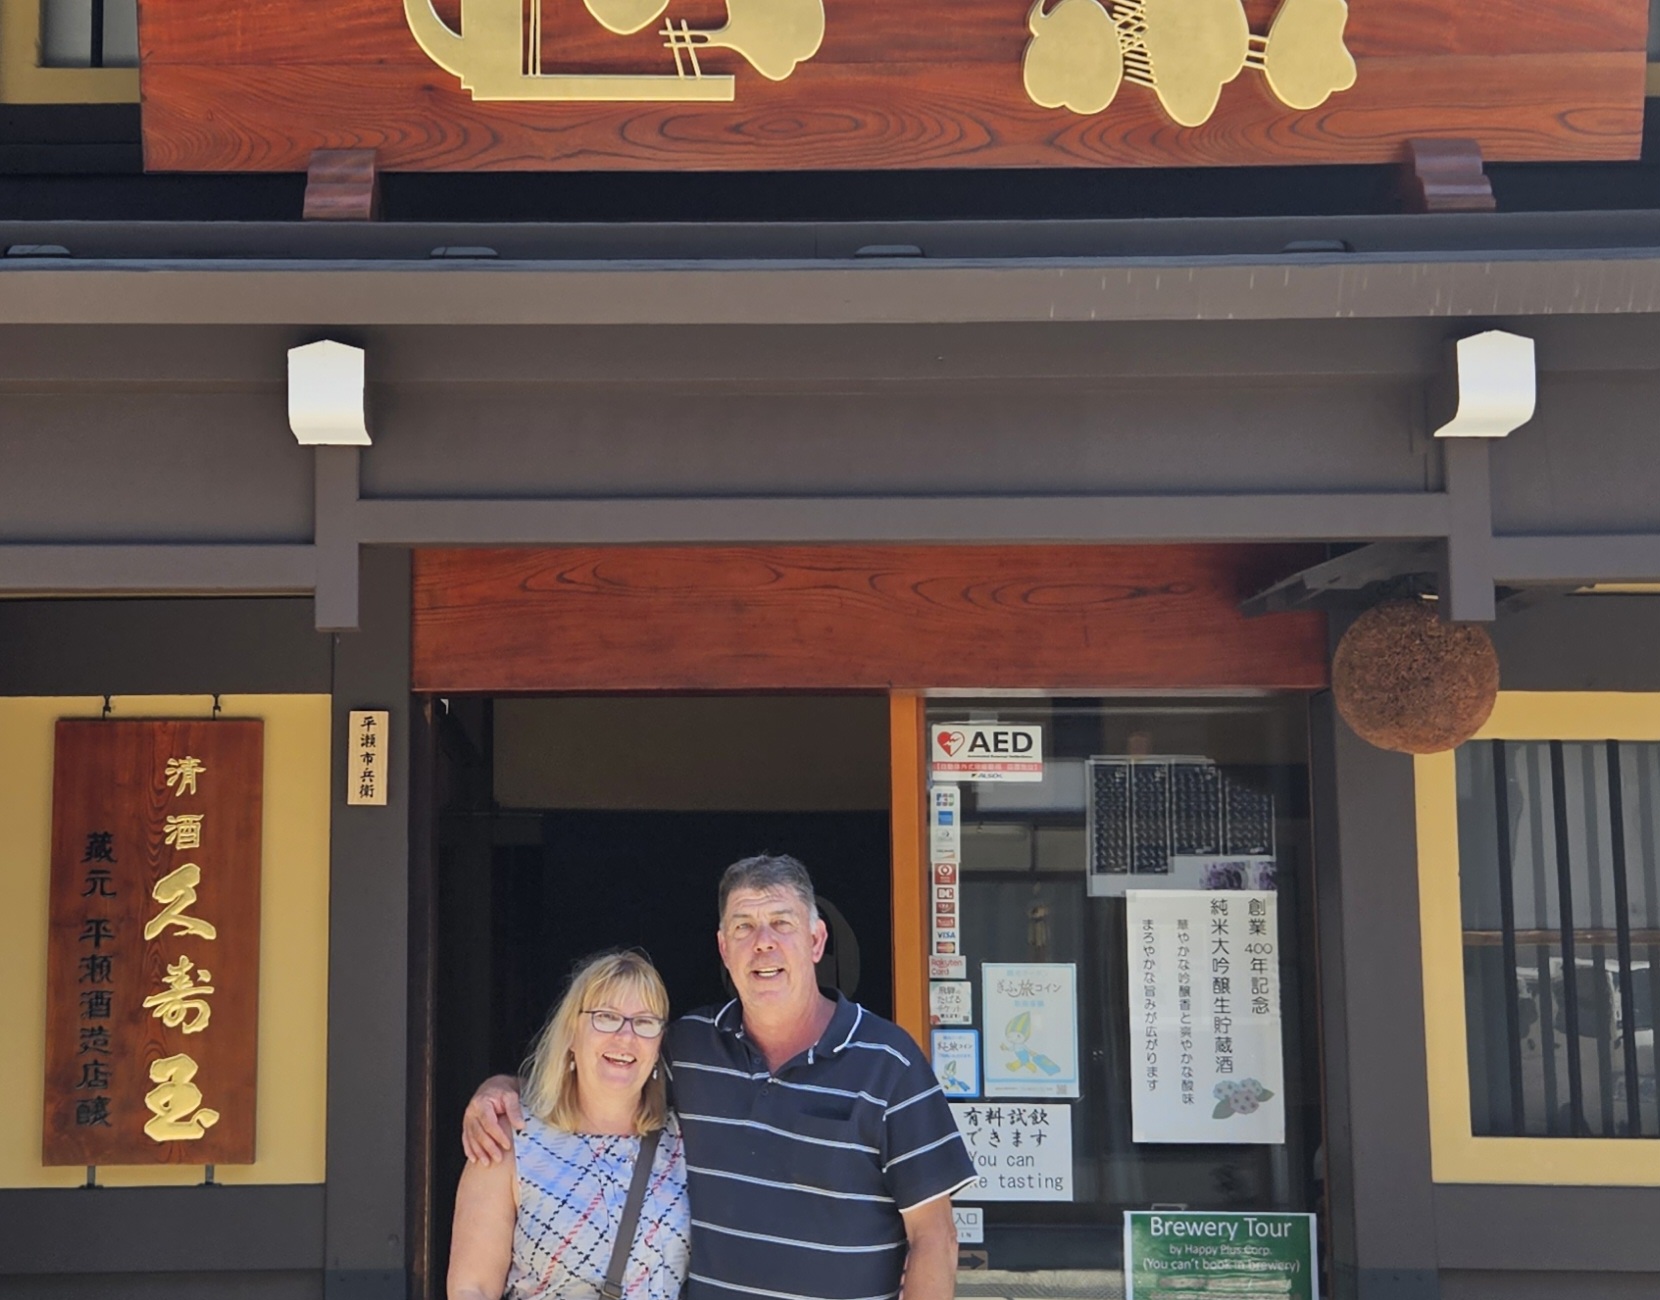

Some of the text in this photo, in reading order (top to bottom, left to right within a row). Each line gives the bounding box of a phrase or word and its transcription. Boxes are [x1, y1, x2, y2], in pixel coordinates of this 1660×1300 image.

[967, 730, 1034, 753] AED
[937, 931, 956, 939] VISA
[143, 756, 220, 1142] 清酒 久寿玉
[1244, 897, 1273, 1015] 創業400年記念
[931, 958, 963, 968] Rakuten
[931, 968, 949, 977] Card
[1210, 897, 1234, 1075] 純米大吟醸生貯蔵酒
[963, 1106, 1050, 1128] 有料試飲
[966, 1128, 1048, 1149] できます
[1006, 1153, 1036, 1168] can
[999, 1172, 1064, 1192] tasting
[955, 1213, 978, 1226] 入口
[1150, 1216, 1293, 1241] Brewery Tour
[1169, 1244, 1184, 1256] by
[1185, 1244, 1217, 1257] Happy
[1220, 1244, 1242, 1256] Plus
[1143, 1258, 1168, 1271] (You
